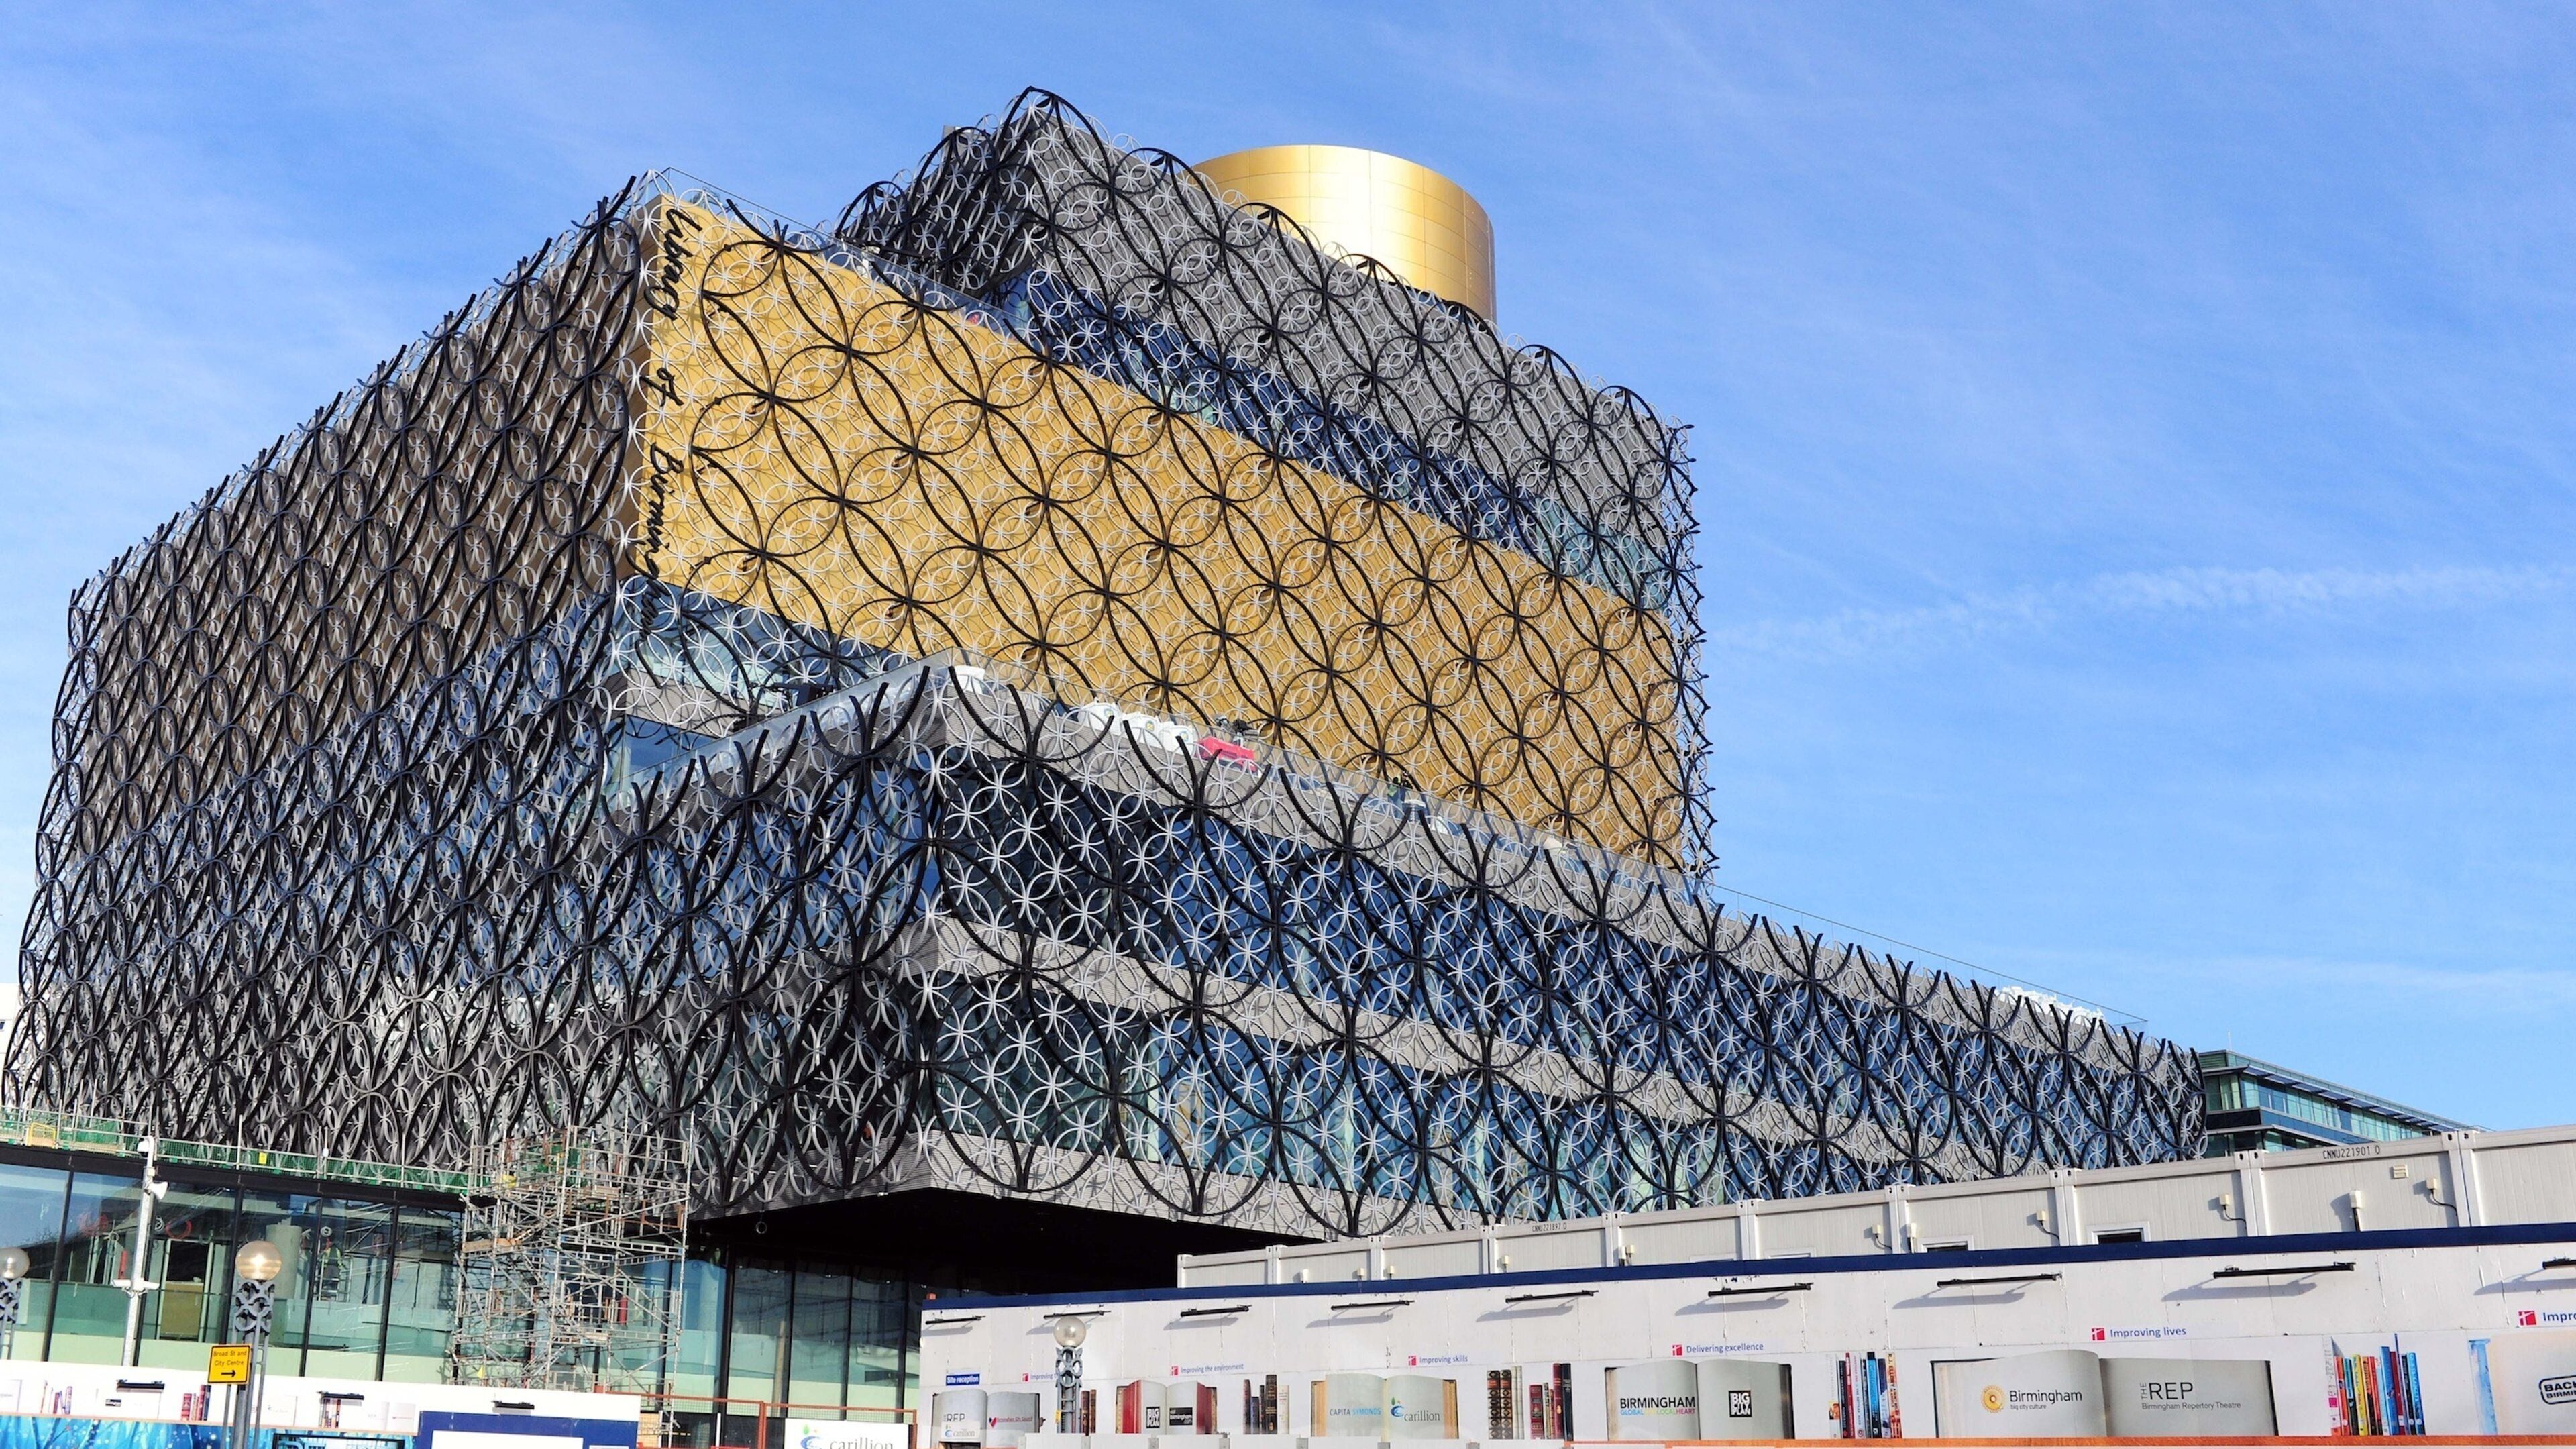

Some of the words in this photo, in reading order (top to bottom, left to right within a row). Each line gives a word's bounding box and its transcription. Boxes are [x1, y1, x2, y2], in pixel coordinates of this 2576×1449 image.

[643, 209, 703, 321] Library
[639, 367, 684, 407] of
[2322, 1146, 2370, 1159] CNNU221901
[2110, 1328, 2161, 1339] Improving
[2163, 1327, 2186, 1336] lives
[1686, 1344, 1723, 1354] Delivering
[1725, 1343, 1764, 1352] excellence
[1419, 1356, 1451, 1364] Improving
[947, 1376, 955, 1384] Site
[957, 1375, 979, 1384] reception
[2009, 1390, 2083, 1404] Birmingham
[2149, 1382, 2194, 1400] REP
[1620, 1397, 1696, 1409] BIRMINGHAM
[1730, 1393, 1750, 1403] BIG
[1147, 1408, 1159, 1417] BIG
[2141, 1402, 2180, 1411] Birmingham
[2182, 1402, 2214, 1410] Repertory
[1403, 1410, 1440, 1422] carillion
